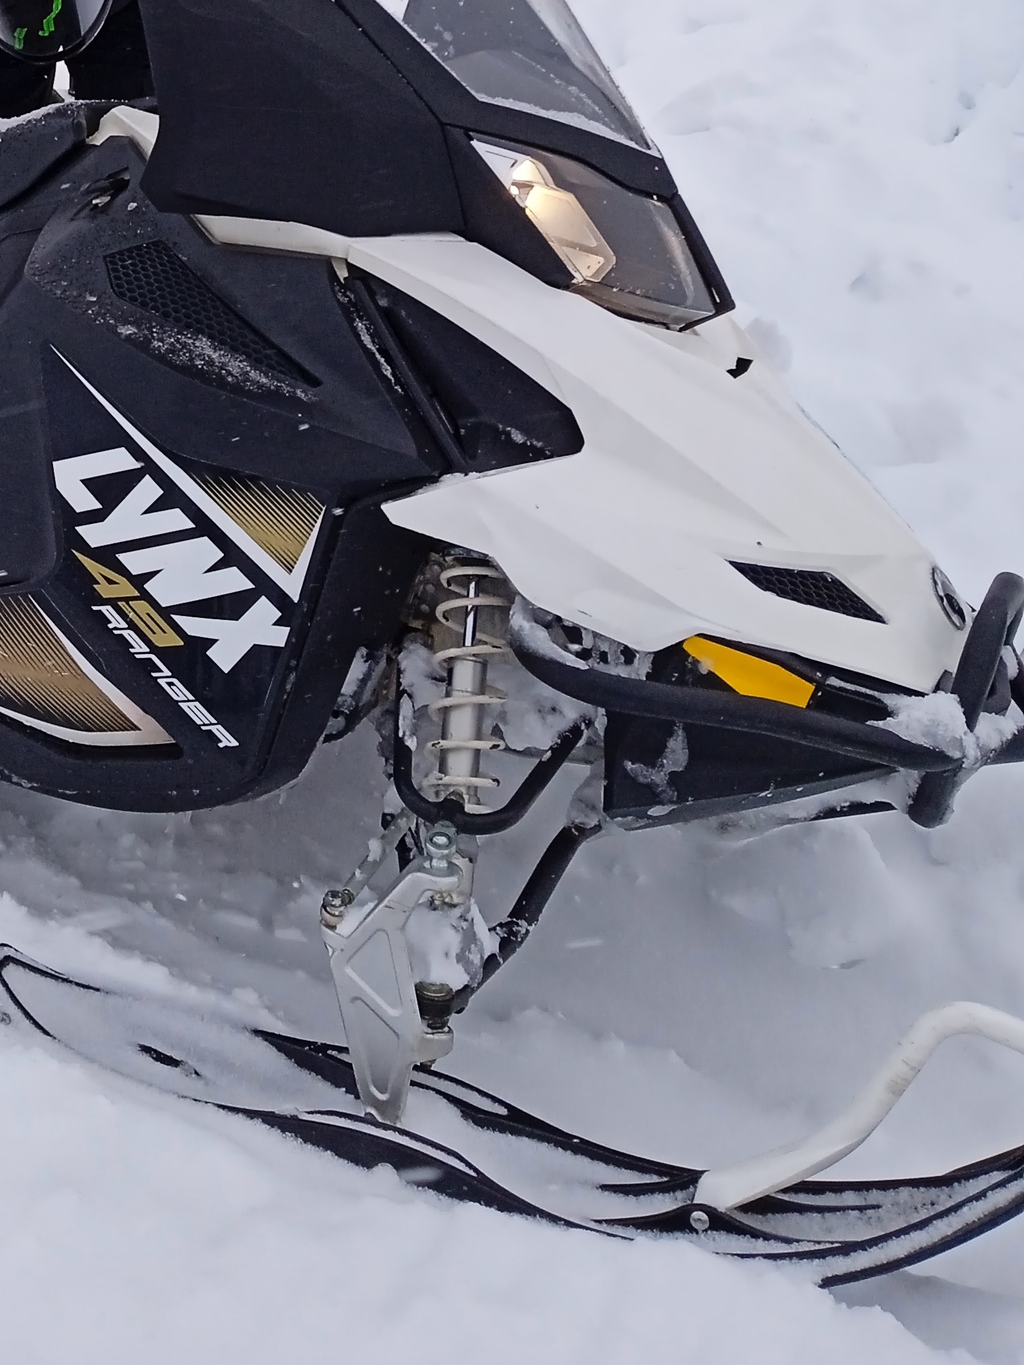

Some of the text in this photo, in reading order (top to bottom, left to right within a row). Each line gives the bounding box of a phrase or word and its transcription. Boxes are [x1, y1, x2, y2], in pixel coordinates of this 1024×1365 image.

[52, 447, 291, 673] LYNX
[71, 549, 184, 647] 49
[91, 605, 240, 748] RANGER
